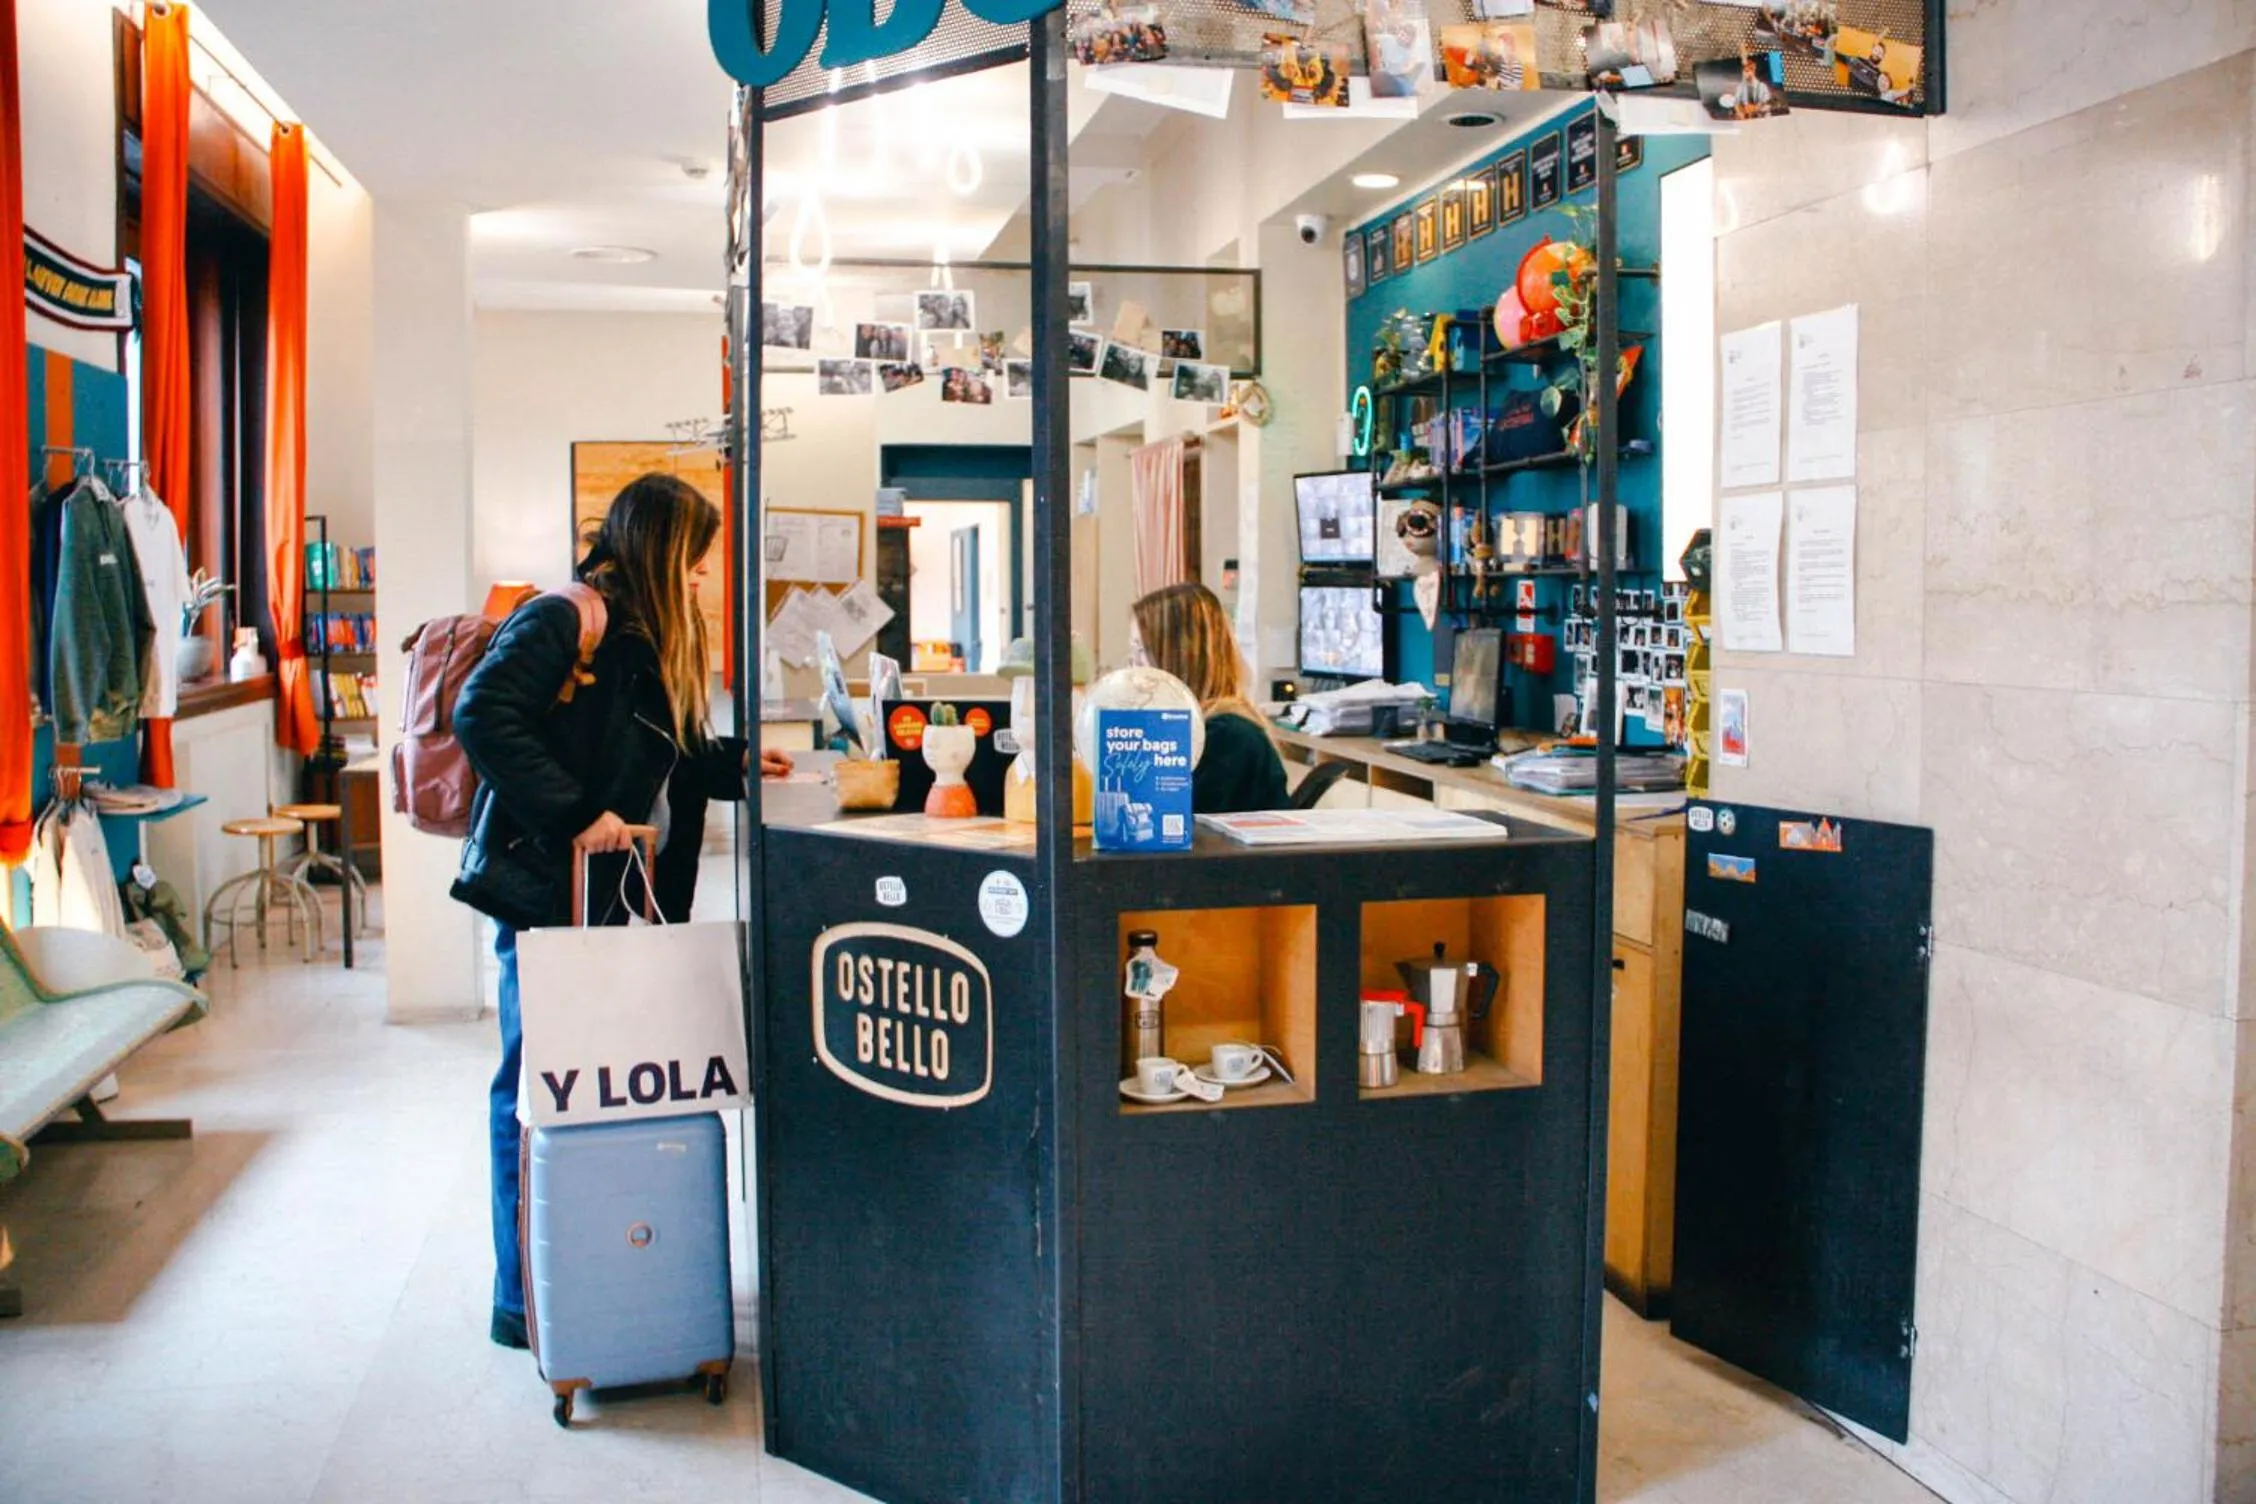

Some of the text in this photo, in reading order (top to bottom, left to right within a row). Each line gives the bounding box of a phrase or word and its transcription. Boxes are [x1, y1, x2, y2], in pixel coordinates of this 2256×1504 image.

[1106, 727, 1143, 738] store
[1106, 738, 1177, 754] your bags
[1154, 753, 1187, 767] here
[837, 951, 969, 1024] OSTELLO
[856, 1012, 949, 1080] BELLO
[541, 1055, 738, 1113] Y LOLA
